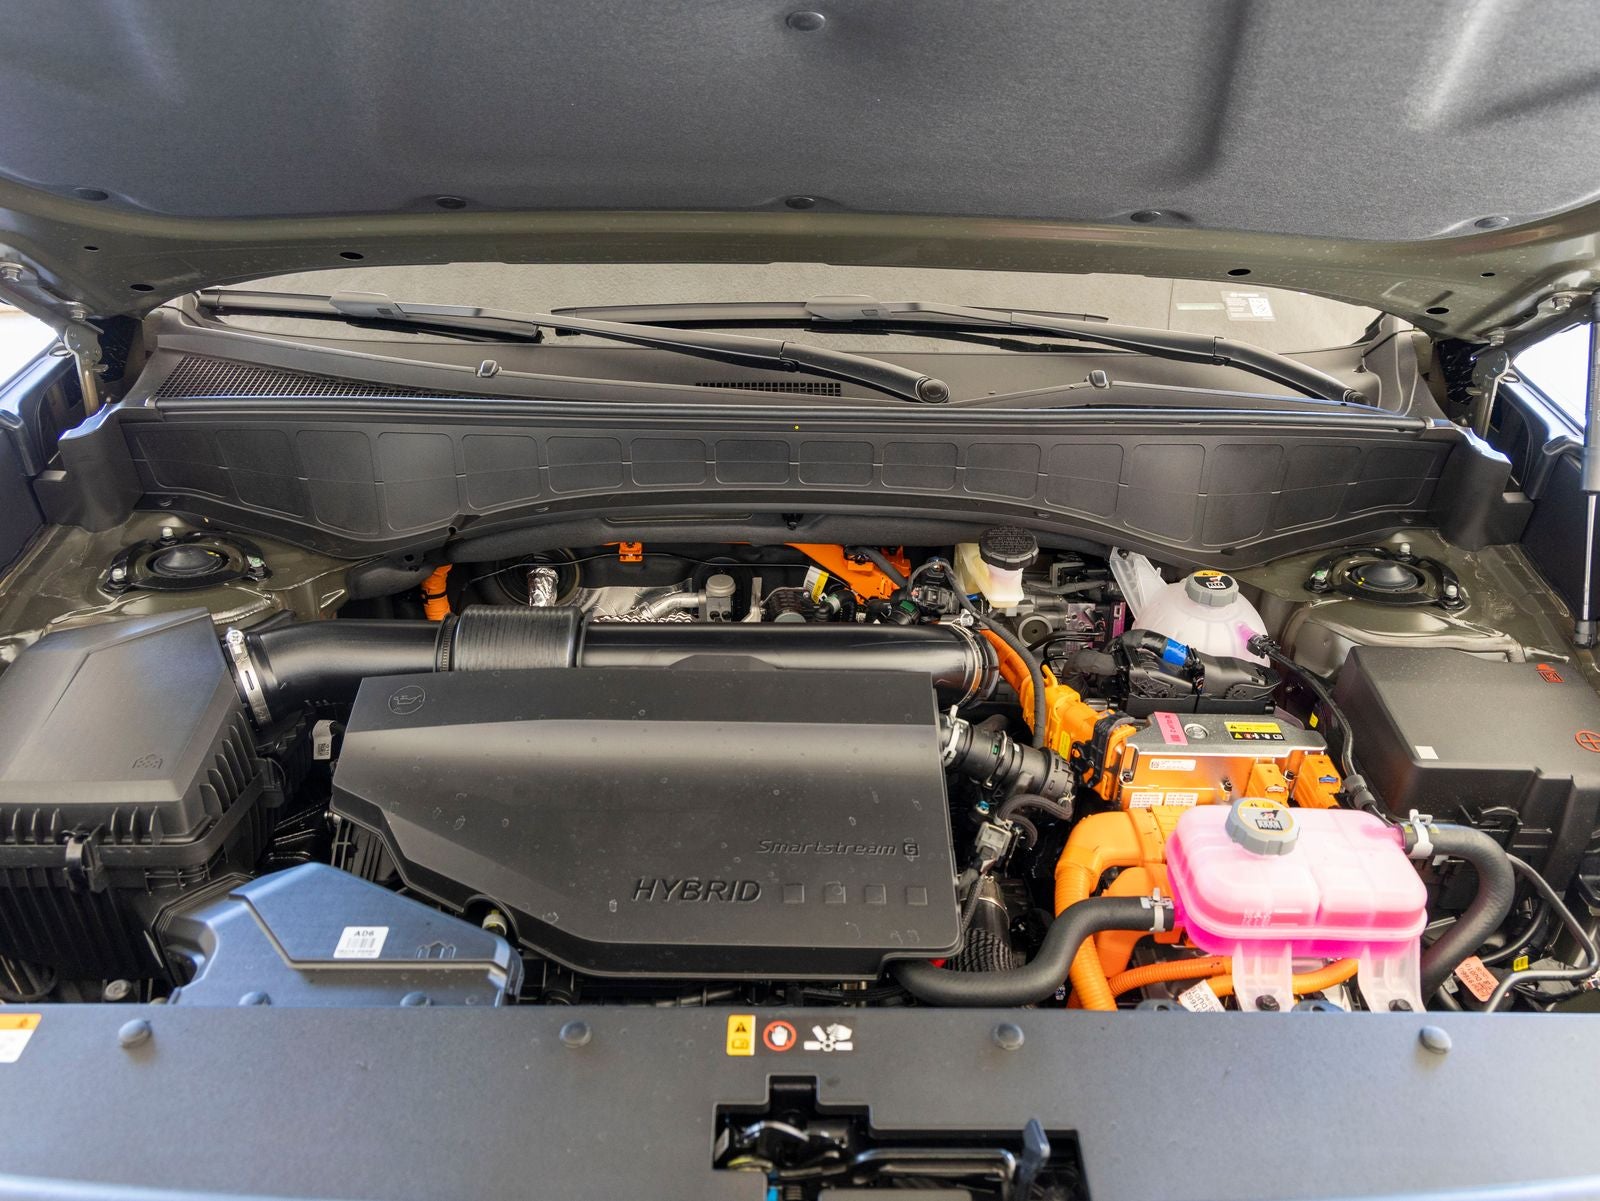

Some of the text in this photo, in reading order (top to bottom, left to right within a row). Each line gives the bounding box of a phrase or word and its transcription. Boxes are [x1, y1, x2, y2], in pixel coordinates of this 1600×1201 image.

[758, 839, 920, 857] Smartstream G
[632, 878, 763, 903] HYBRID
